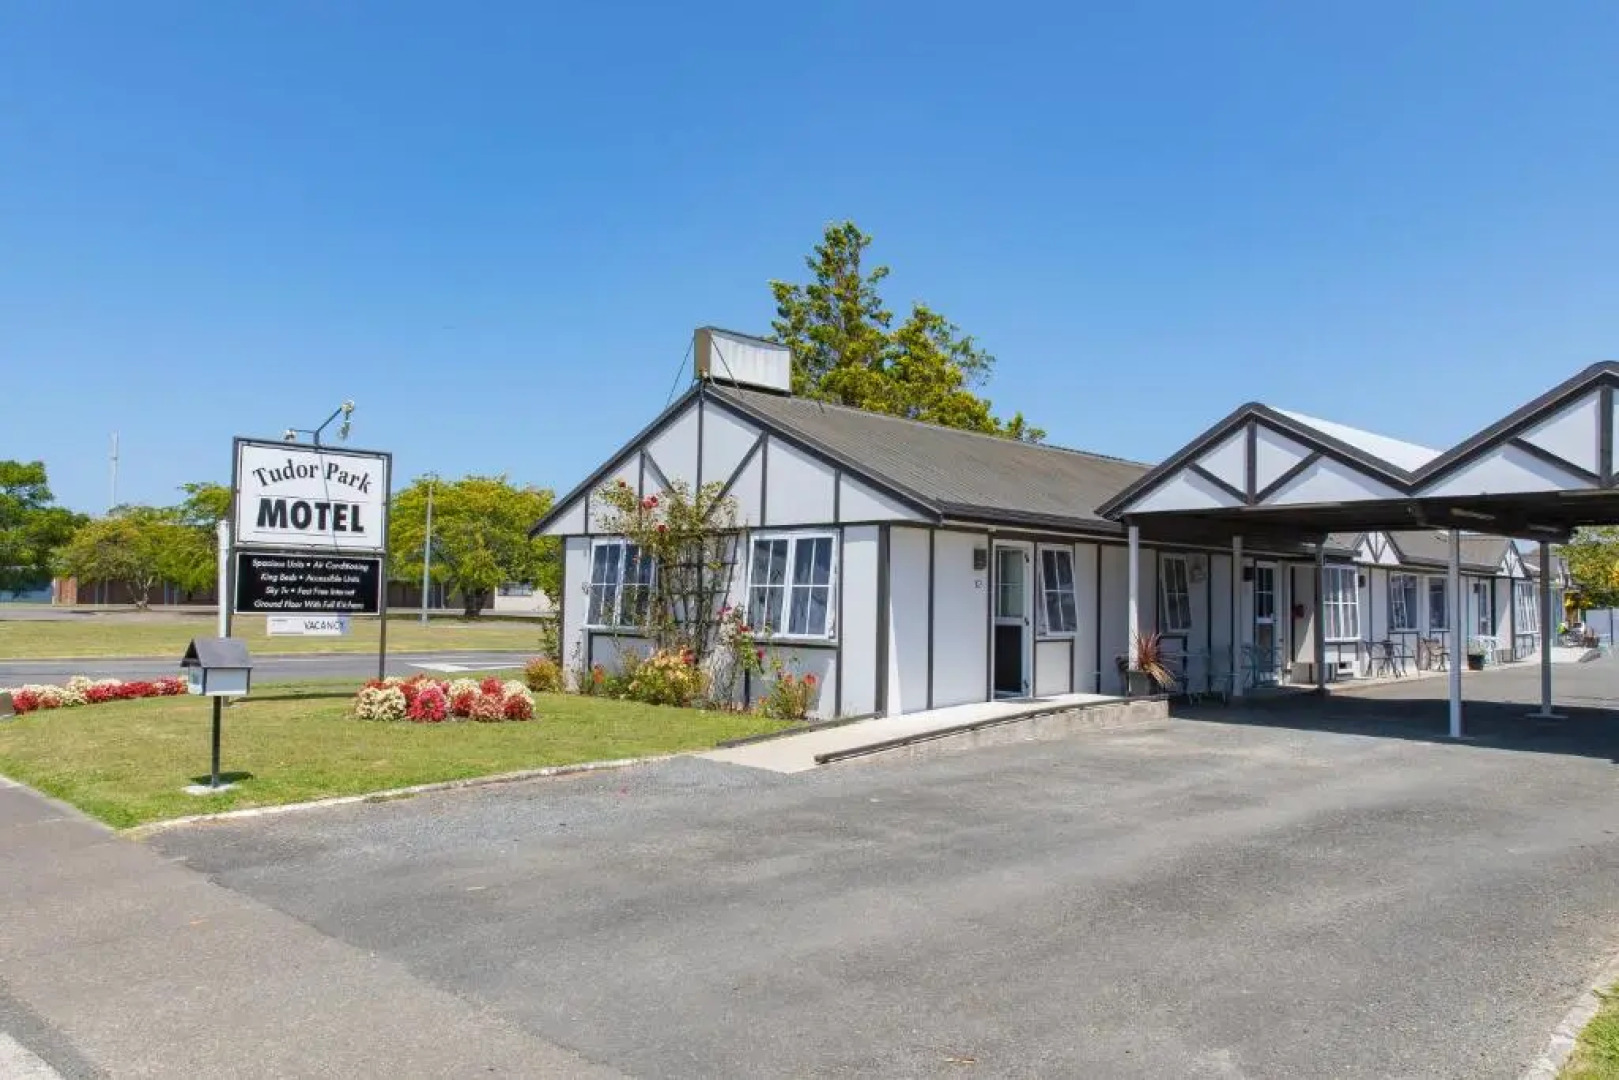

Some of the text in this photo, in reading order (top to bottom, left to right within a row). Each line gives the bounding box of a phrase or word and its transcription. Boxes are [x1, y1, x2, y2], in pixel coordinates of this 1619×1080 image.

[253, 458, 372, 494] Tudor Park
[256, 497, 365, 533] MOTEL
[313, 560, 324, 569] Air
[325, 560, 369, 573] Conditioning
[253, 599, 284, 608] Ground
[284, 600, 303, 608] Floor
[304, 600, 321, 608] With
[304, 620, 344, 631] VACANCY
